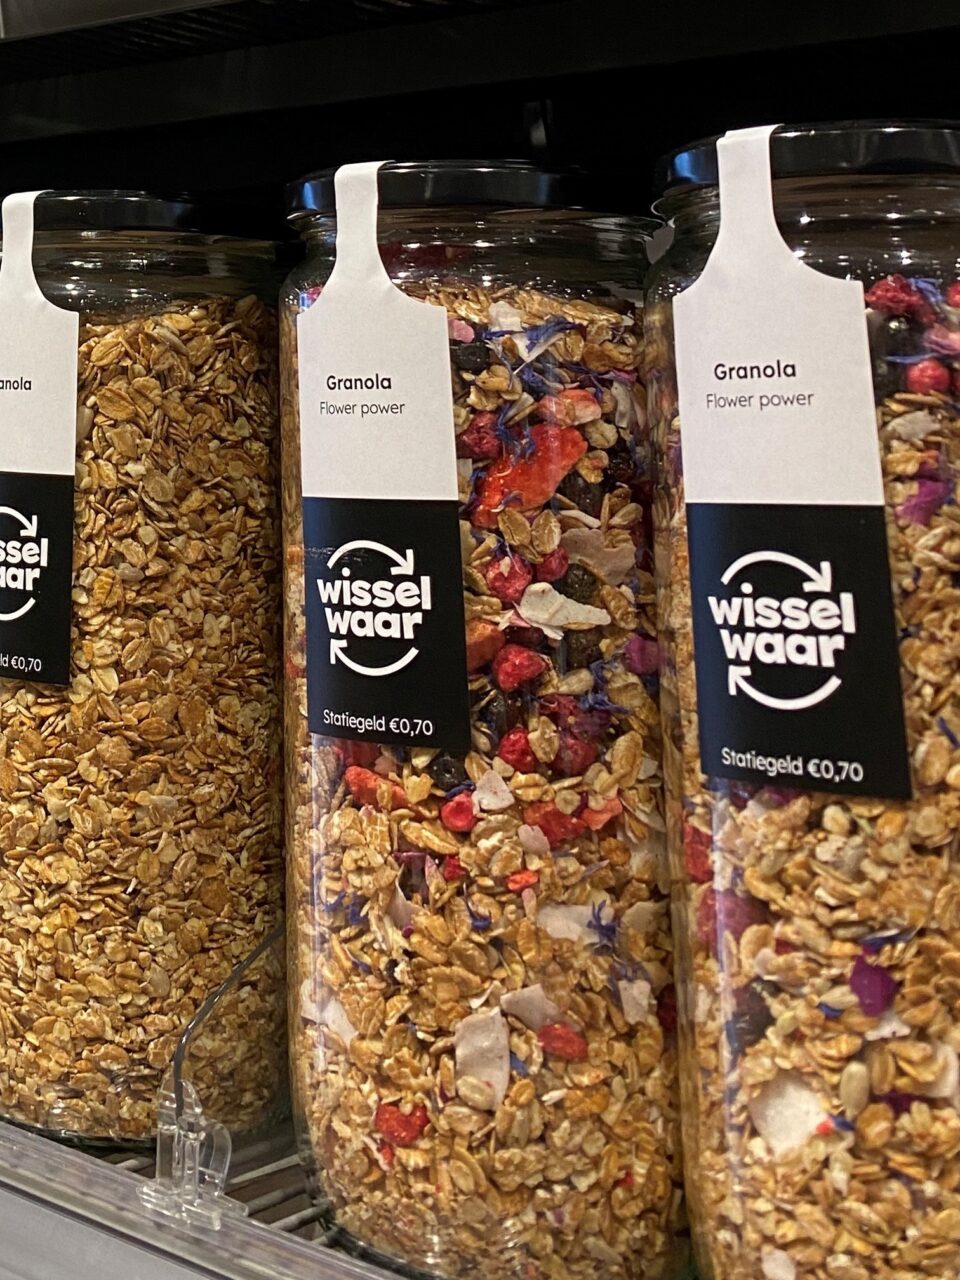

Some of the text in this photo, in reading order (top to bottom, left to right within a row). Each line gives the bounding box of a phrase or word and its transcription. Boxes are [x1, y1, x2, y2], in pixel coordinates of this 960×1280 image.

[326, 372, 393, 392] Granola
[713, 359, 798, 382] Granola
[319, 400, 406, 418] Flower power
[705, 390, 815, 411] Flower power
[316, 568, 432, 611] wissel
[707, 583, 857, 634] wissel
[324, 607, 423, 641] waar
[720, 629, 846, 668] waar
[10, 655, 42, 672] €0,70
[322, 708, 434, 737] Statiegeld €0,70
[720, 746, 864, 784] Statiegeld €0,70
